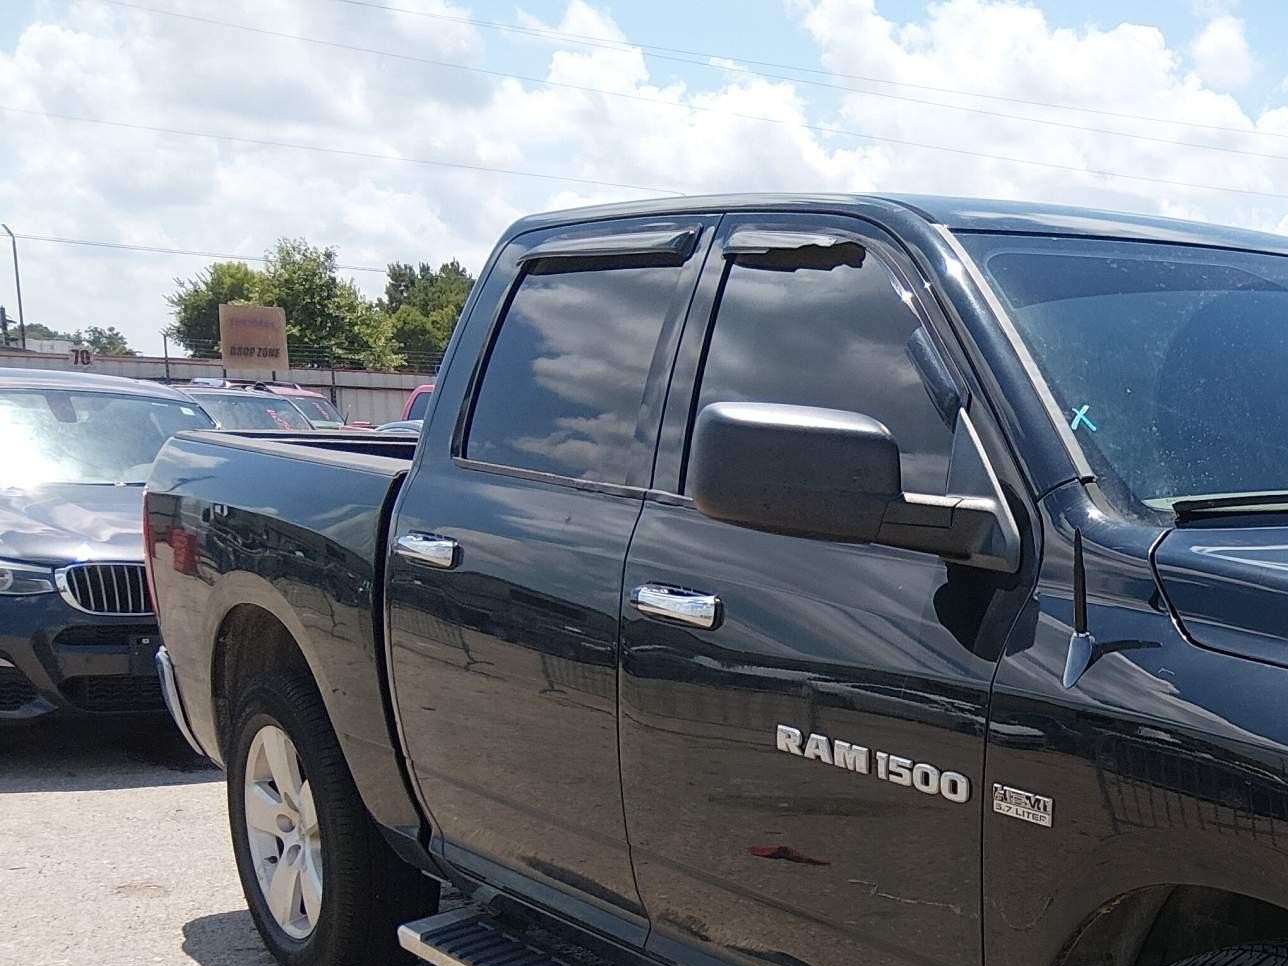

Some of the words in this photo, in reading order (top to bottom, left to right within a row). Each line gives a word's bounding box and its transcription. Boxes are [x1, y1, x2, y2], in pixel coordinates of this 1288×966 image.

[71, 349, 91, 365] 70
[776, 724, 870, 775] RAM
[875, 751, 970, 803] 1500
[993, 784, 1052, 815] HEMI
[995, 802, 1013, 813] 5.7
[1015, 808, 1048, 823] LITER
